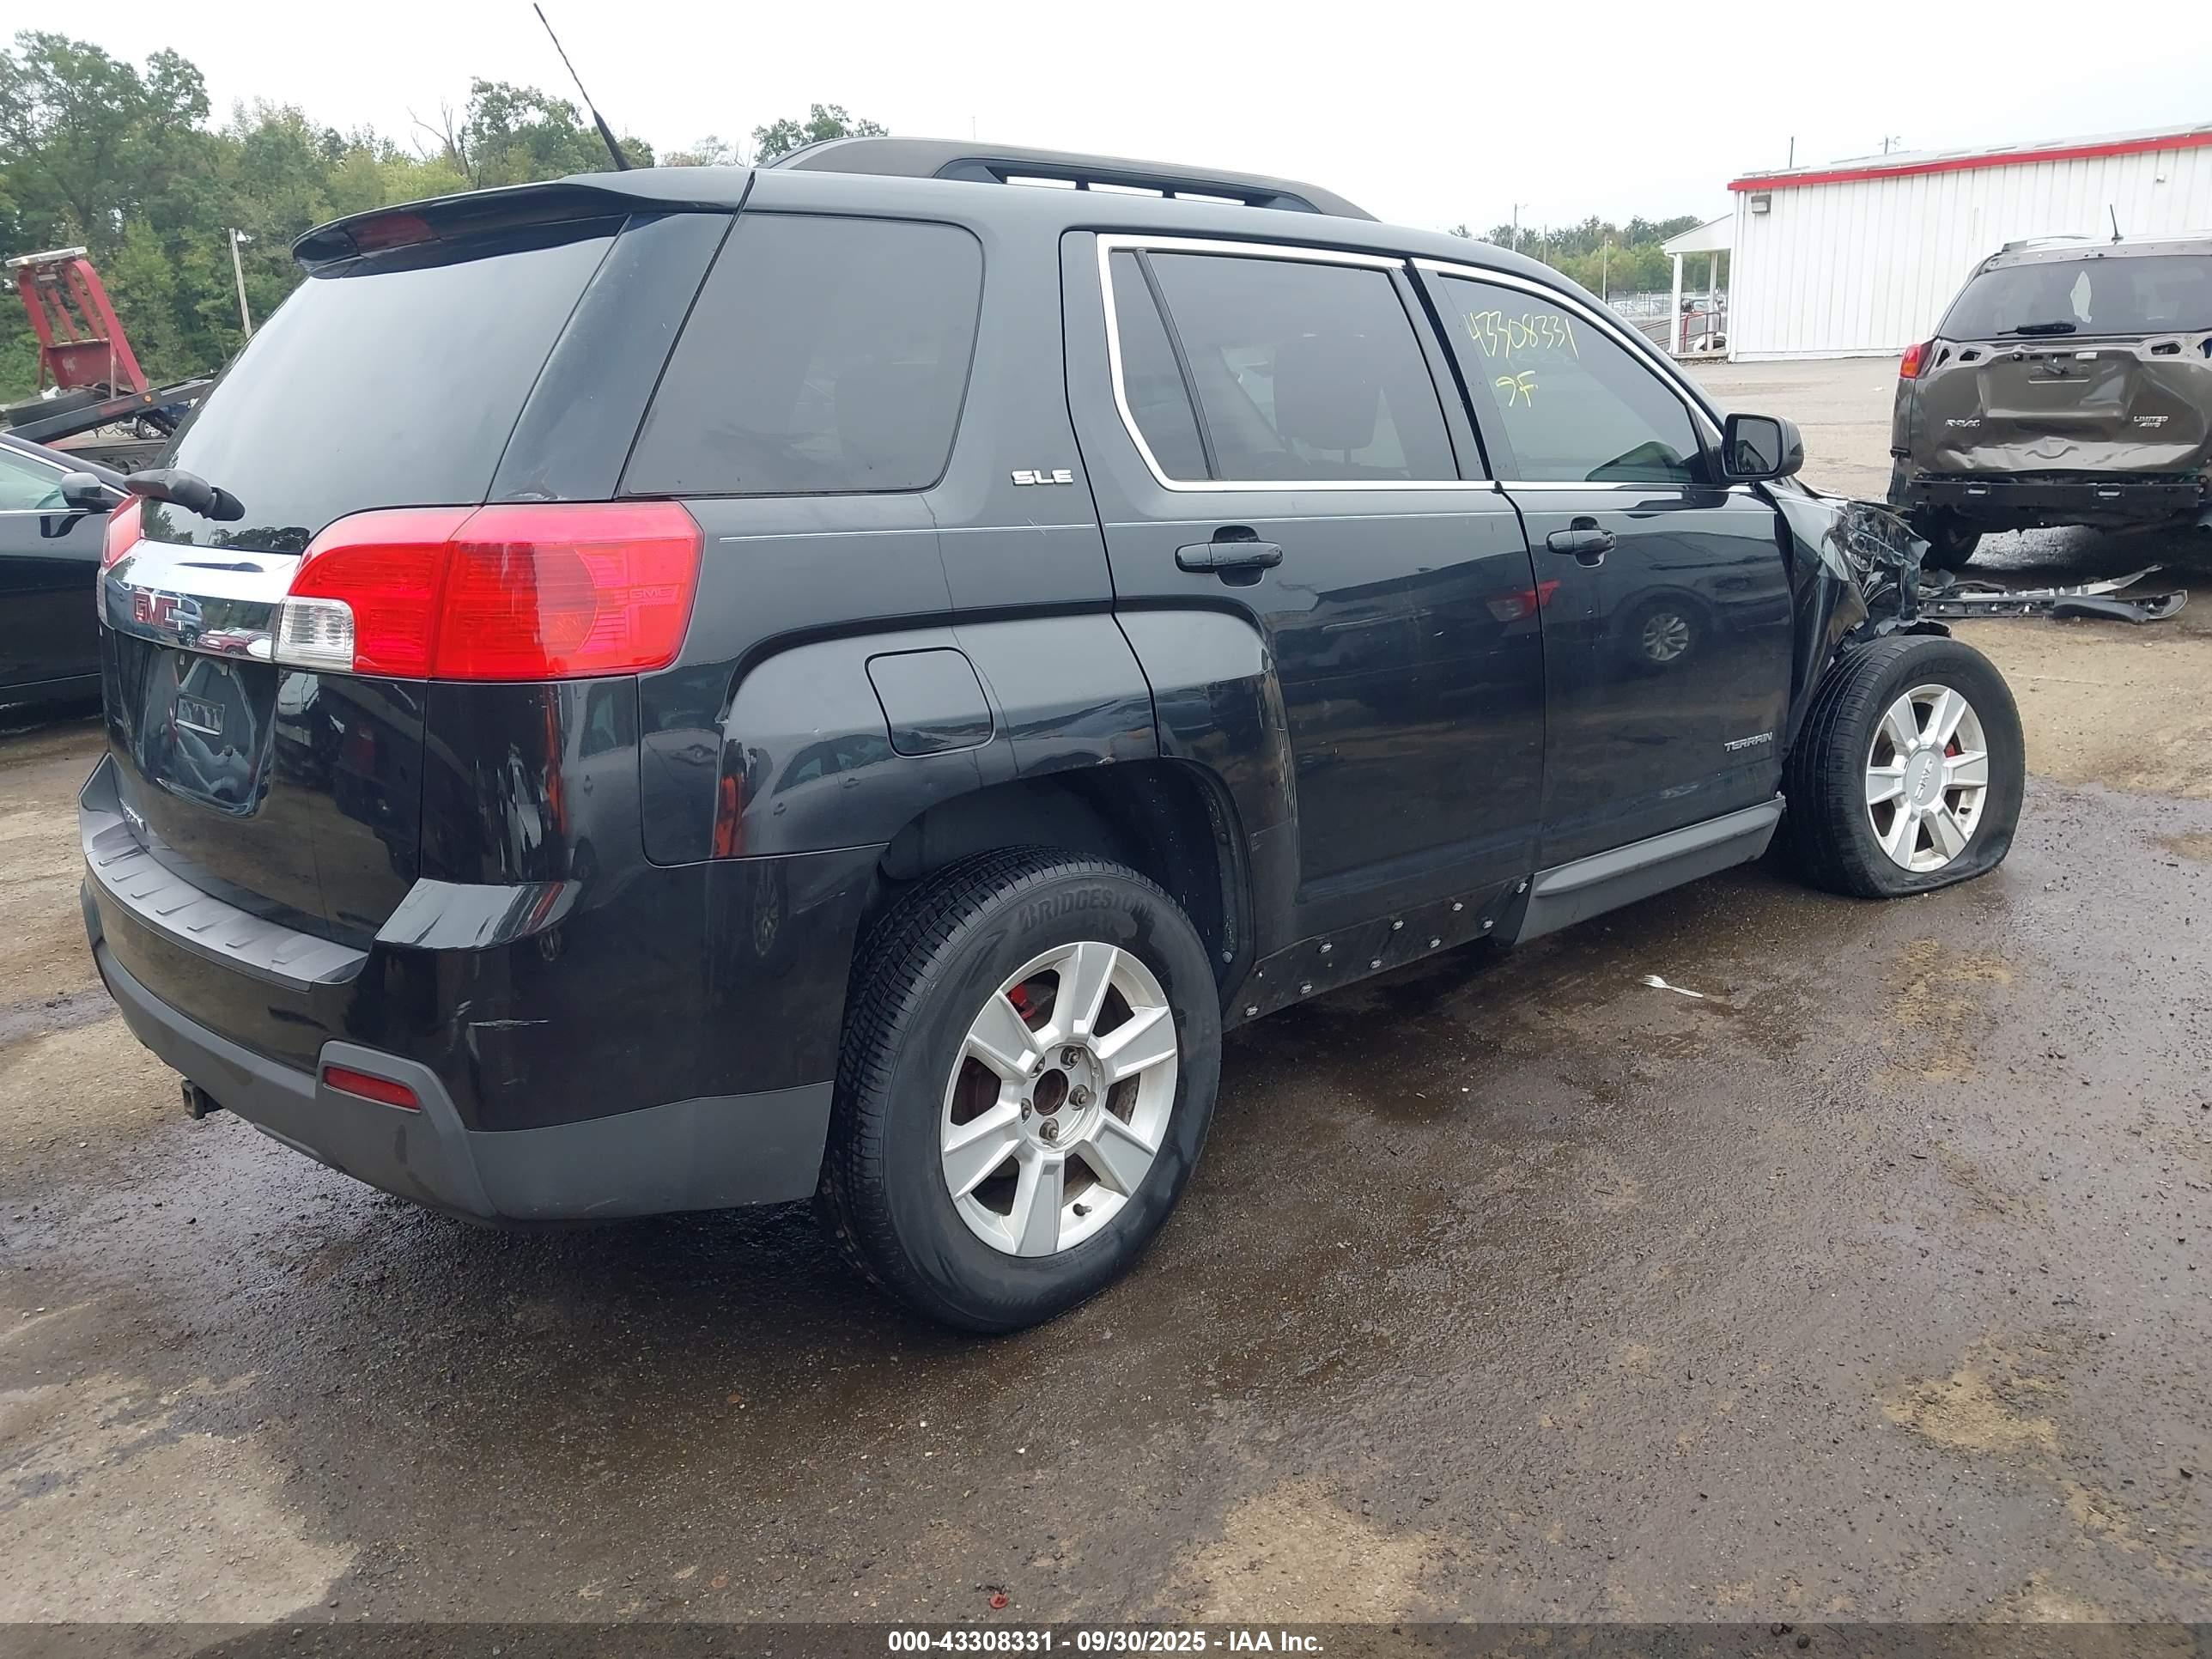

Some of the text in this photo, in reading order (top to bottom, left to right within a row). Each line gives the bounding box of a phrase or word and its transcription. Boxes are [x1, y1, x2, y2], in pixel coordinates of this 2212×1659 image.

[1463, 311, 1579, 358] 43308331
[1012, 469, 1073, 485] SLE
[133, 590, 183, 631] GMC
[1723, 732, 1773, 752] TERRAIN
